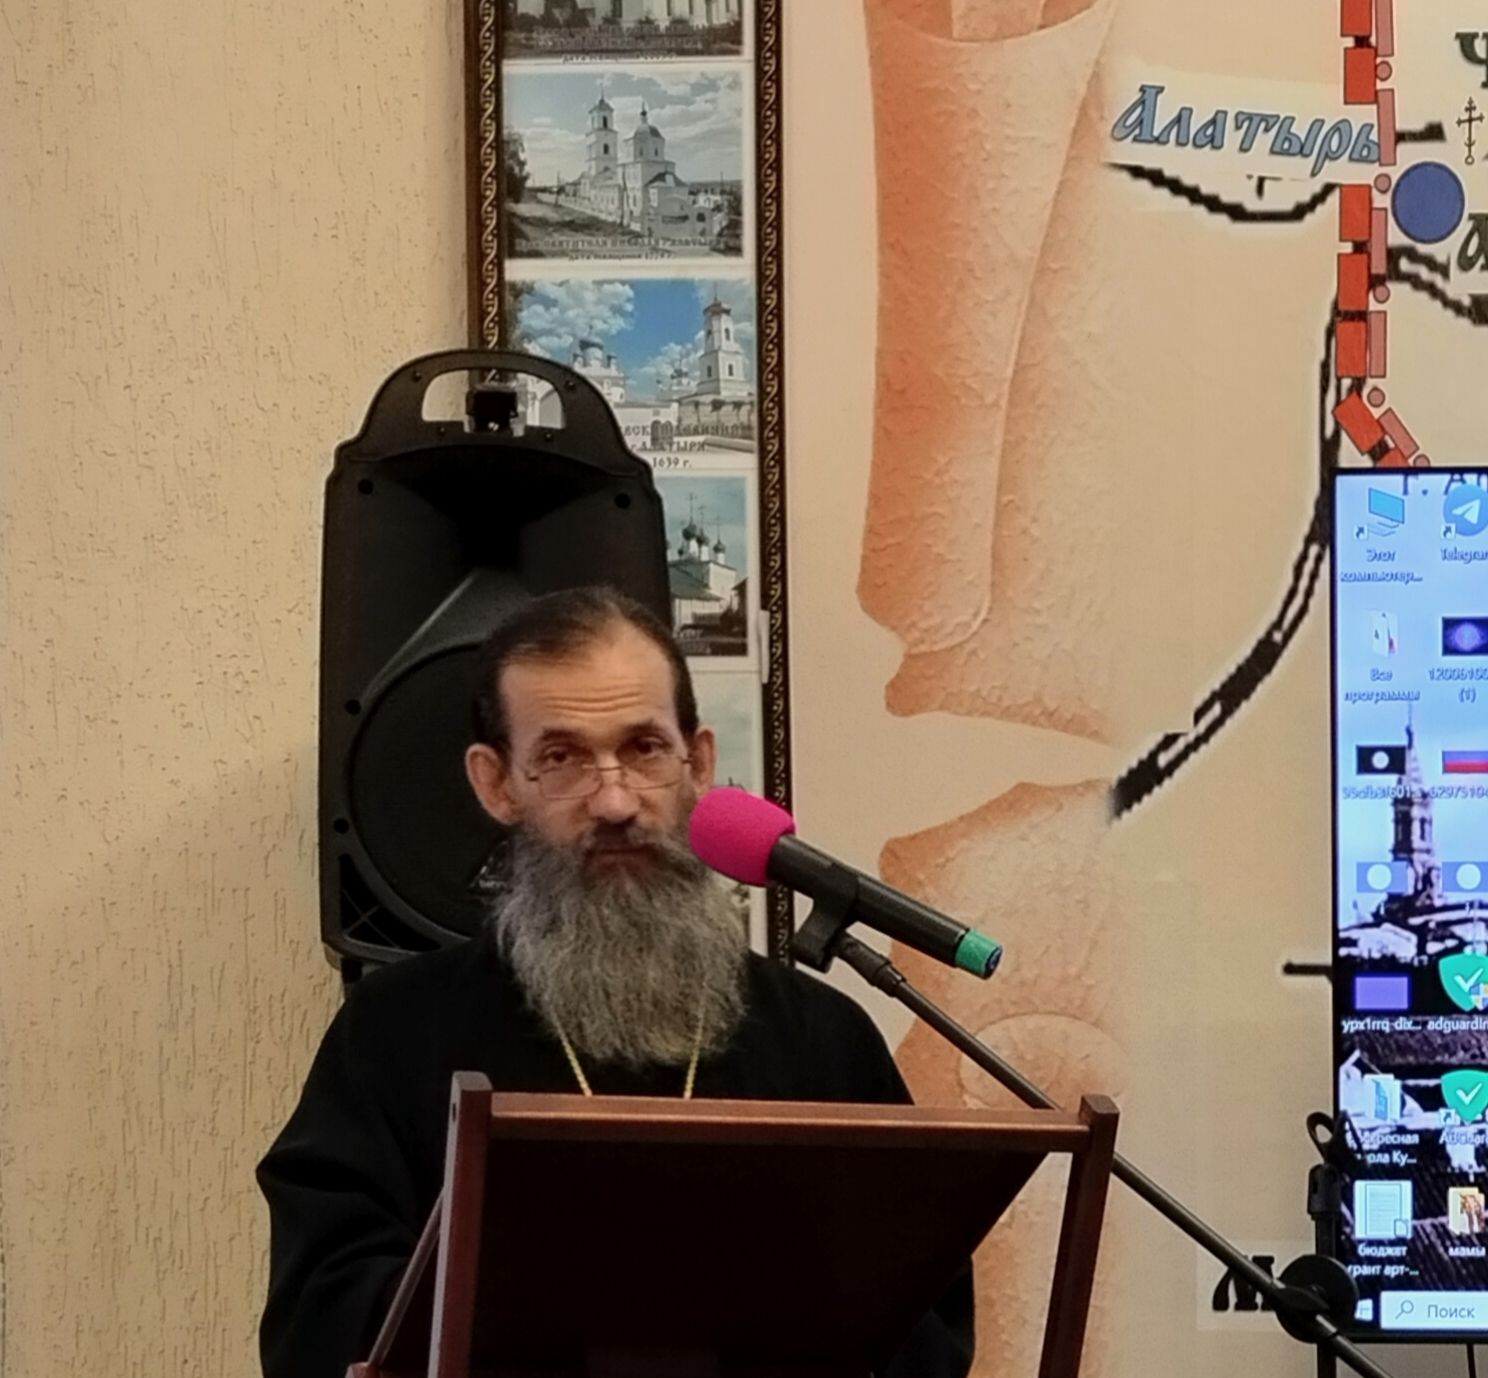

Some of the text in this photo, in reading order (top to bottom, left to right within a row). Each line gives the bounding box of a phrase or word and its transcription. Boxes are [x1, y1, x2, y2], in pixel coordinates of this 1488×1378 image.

[1111, 84, 1381, 177] Алатырь
[653, 457, 679, 467] 1639
[1427, 1304, 1475, 1319] Поиск
